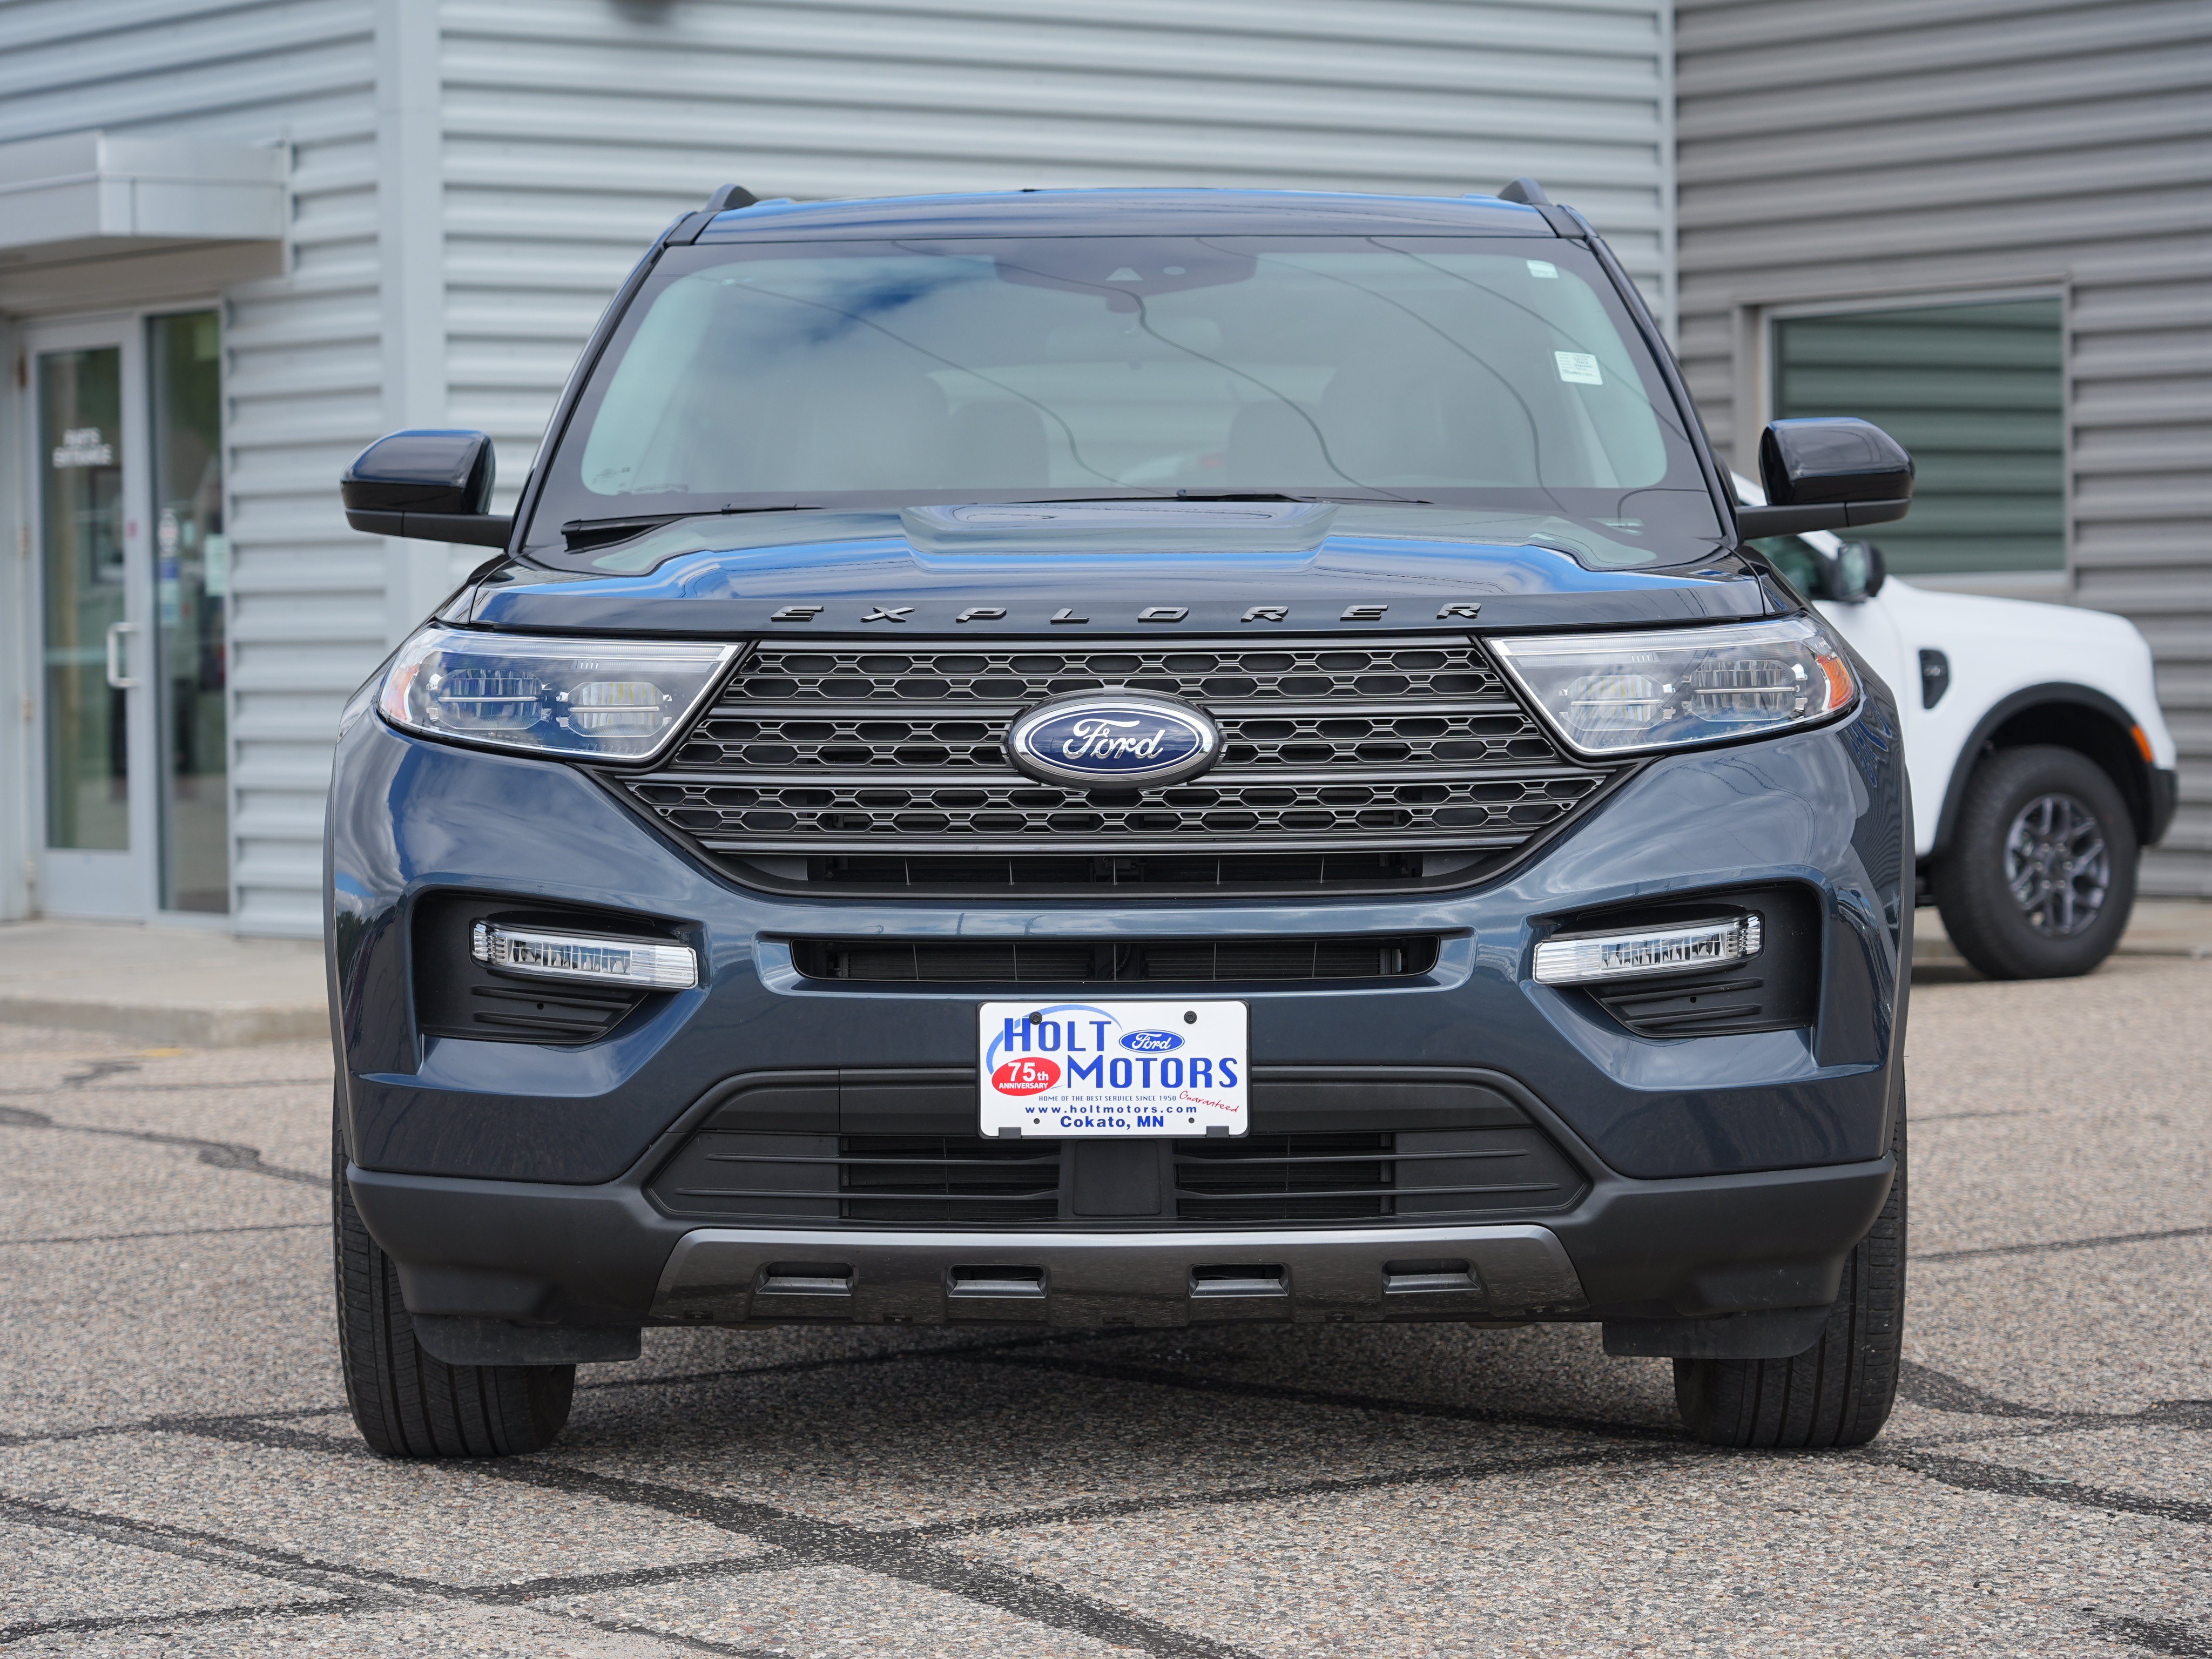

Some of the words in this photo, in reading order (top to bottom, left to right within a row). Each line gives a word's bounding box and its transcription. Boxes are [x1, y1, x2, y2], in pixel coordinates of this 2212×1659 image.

[771, 602, 1482, 623] EXPLORER
[1062, 718, 1166, 760] Ford
[1004, 1017, 1112, 1051] HOLT
[1131, 1032, 1172, 1049] Ford
[1008, 1062, 1049, 1082] 75th
[1067, 1054, 1238, 1088] MOTORS
[1025, 1105, 1197, 1114] www.holtmotors.com
[1179, 1090, 1239, 1112] Guaranteed
[1060, 1116, 1131, 1130] Cokato,
[1137, 1116, 1164, 1127] MN
